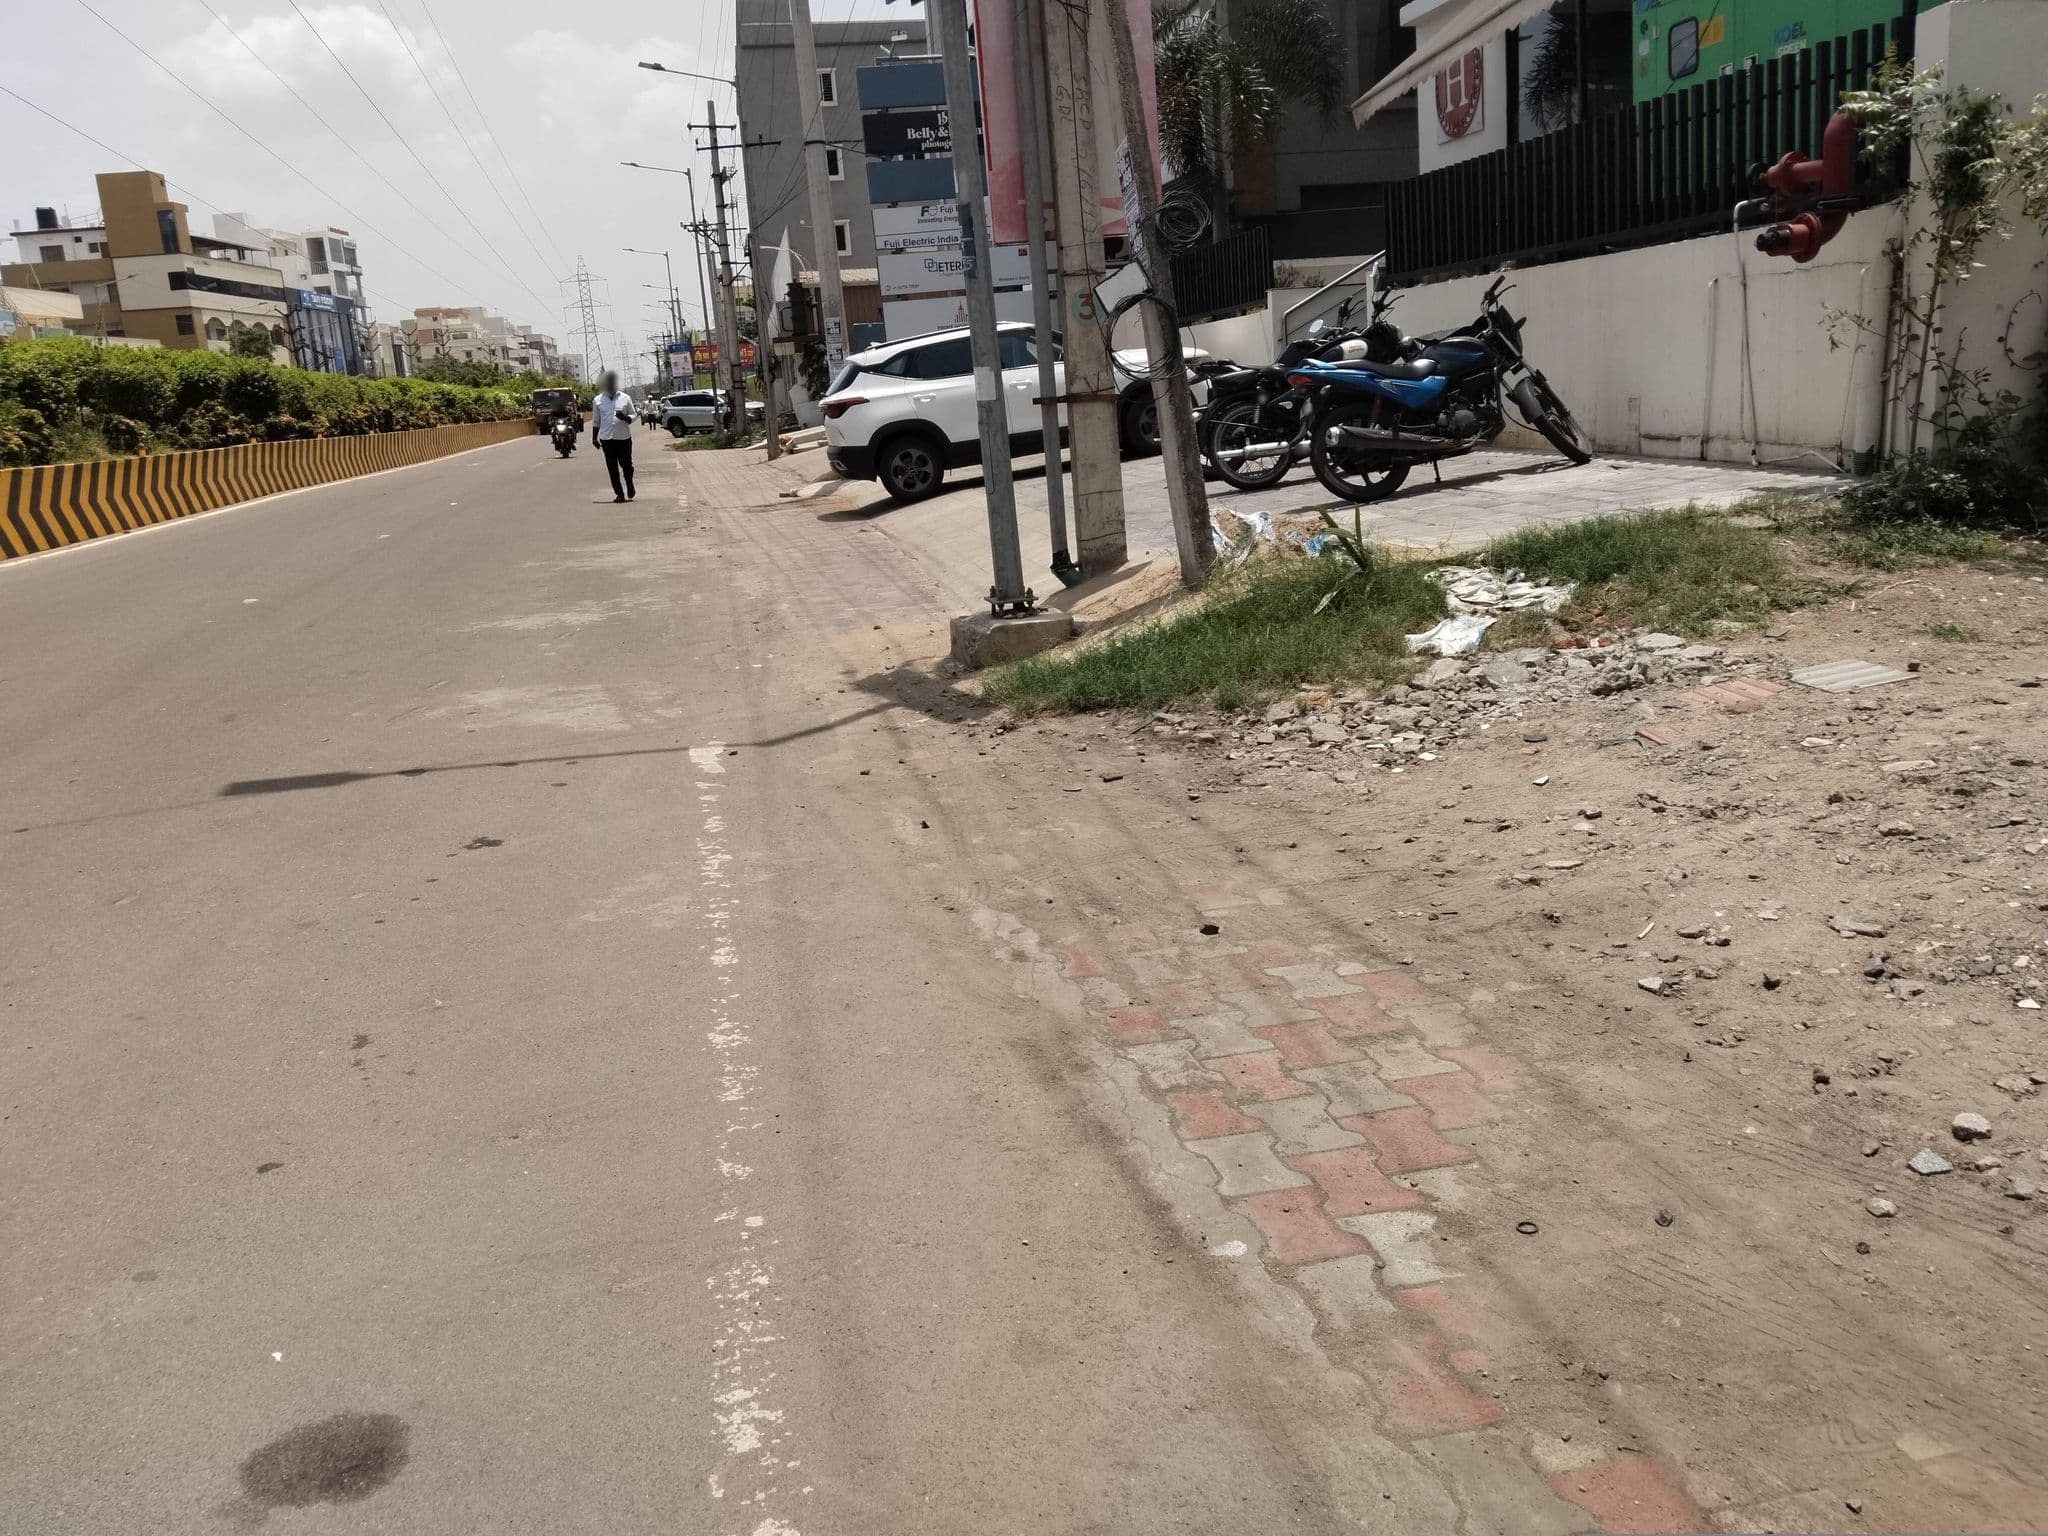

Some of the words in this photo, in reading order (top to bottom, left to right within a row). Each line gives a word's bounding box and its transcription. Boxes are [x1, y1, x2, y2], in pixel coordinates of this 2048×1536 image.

[884, 240, 901, 250] Fuji
[902, 237, 936, 248] Electric
[938, 234, 959, 244] India
[1078, 293, 1096, 321] 3
